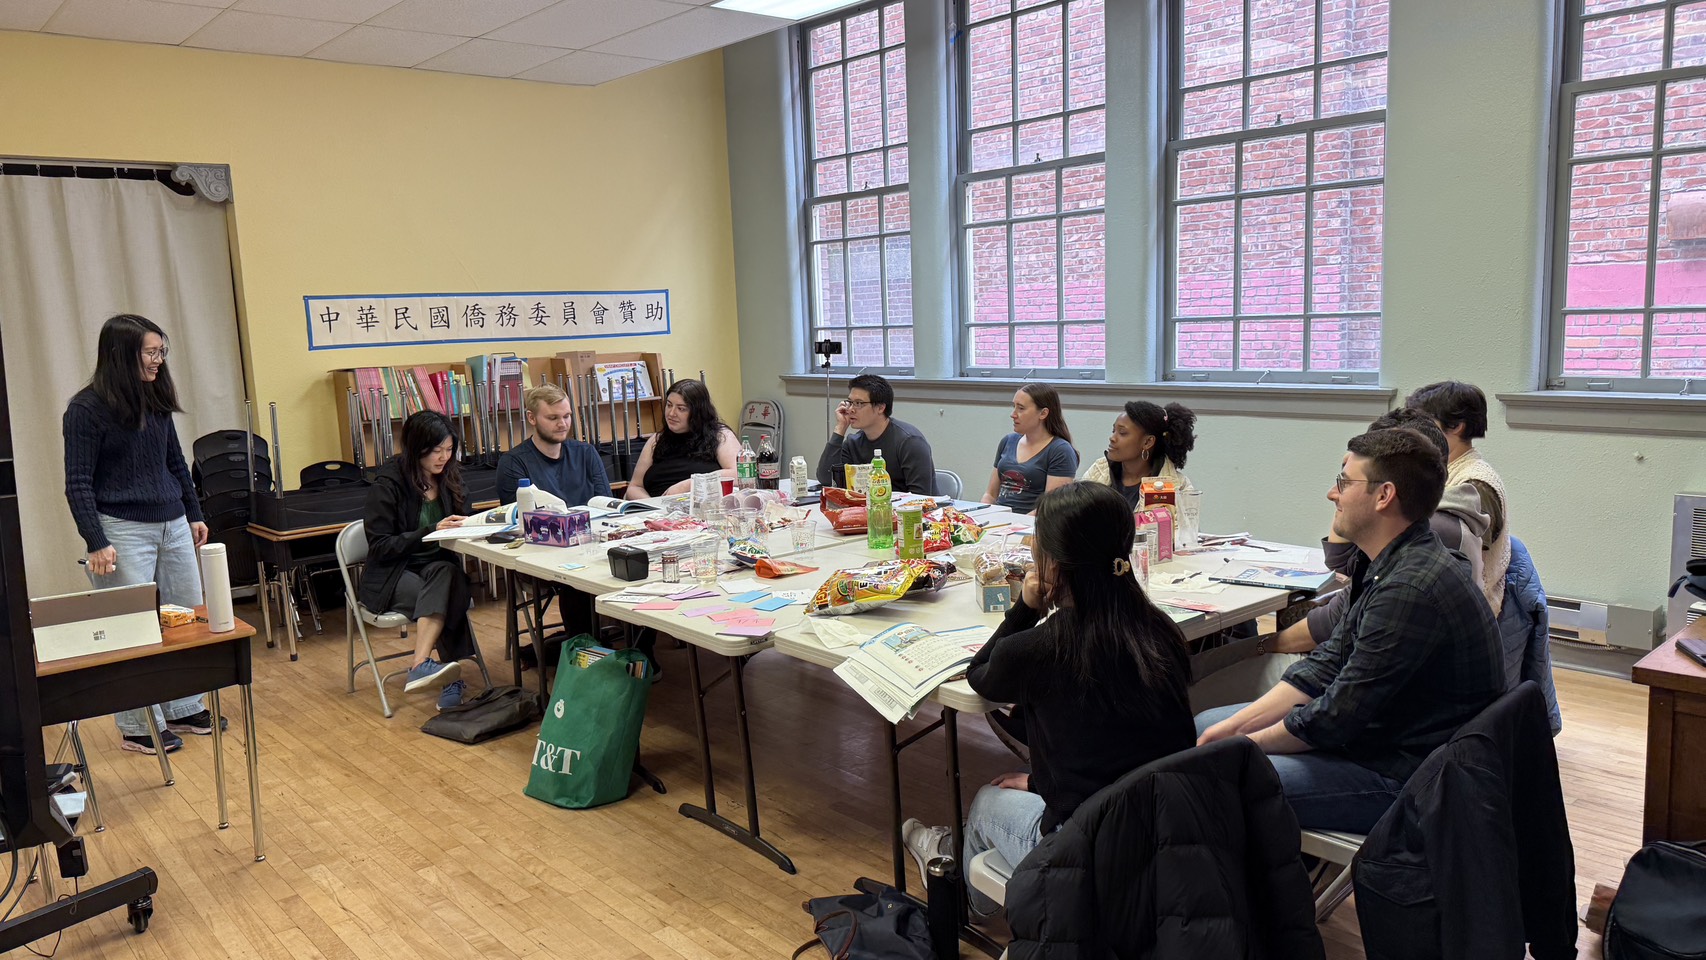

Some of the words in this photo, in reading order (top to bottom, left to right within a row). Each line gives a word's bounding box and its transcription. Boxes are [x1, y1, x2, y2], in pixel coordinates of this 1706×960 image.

[319, 299, 664, 334] 中華民國僑務委員會贊助
